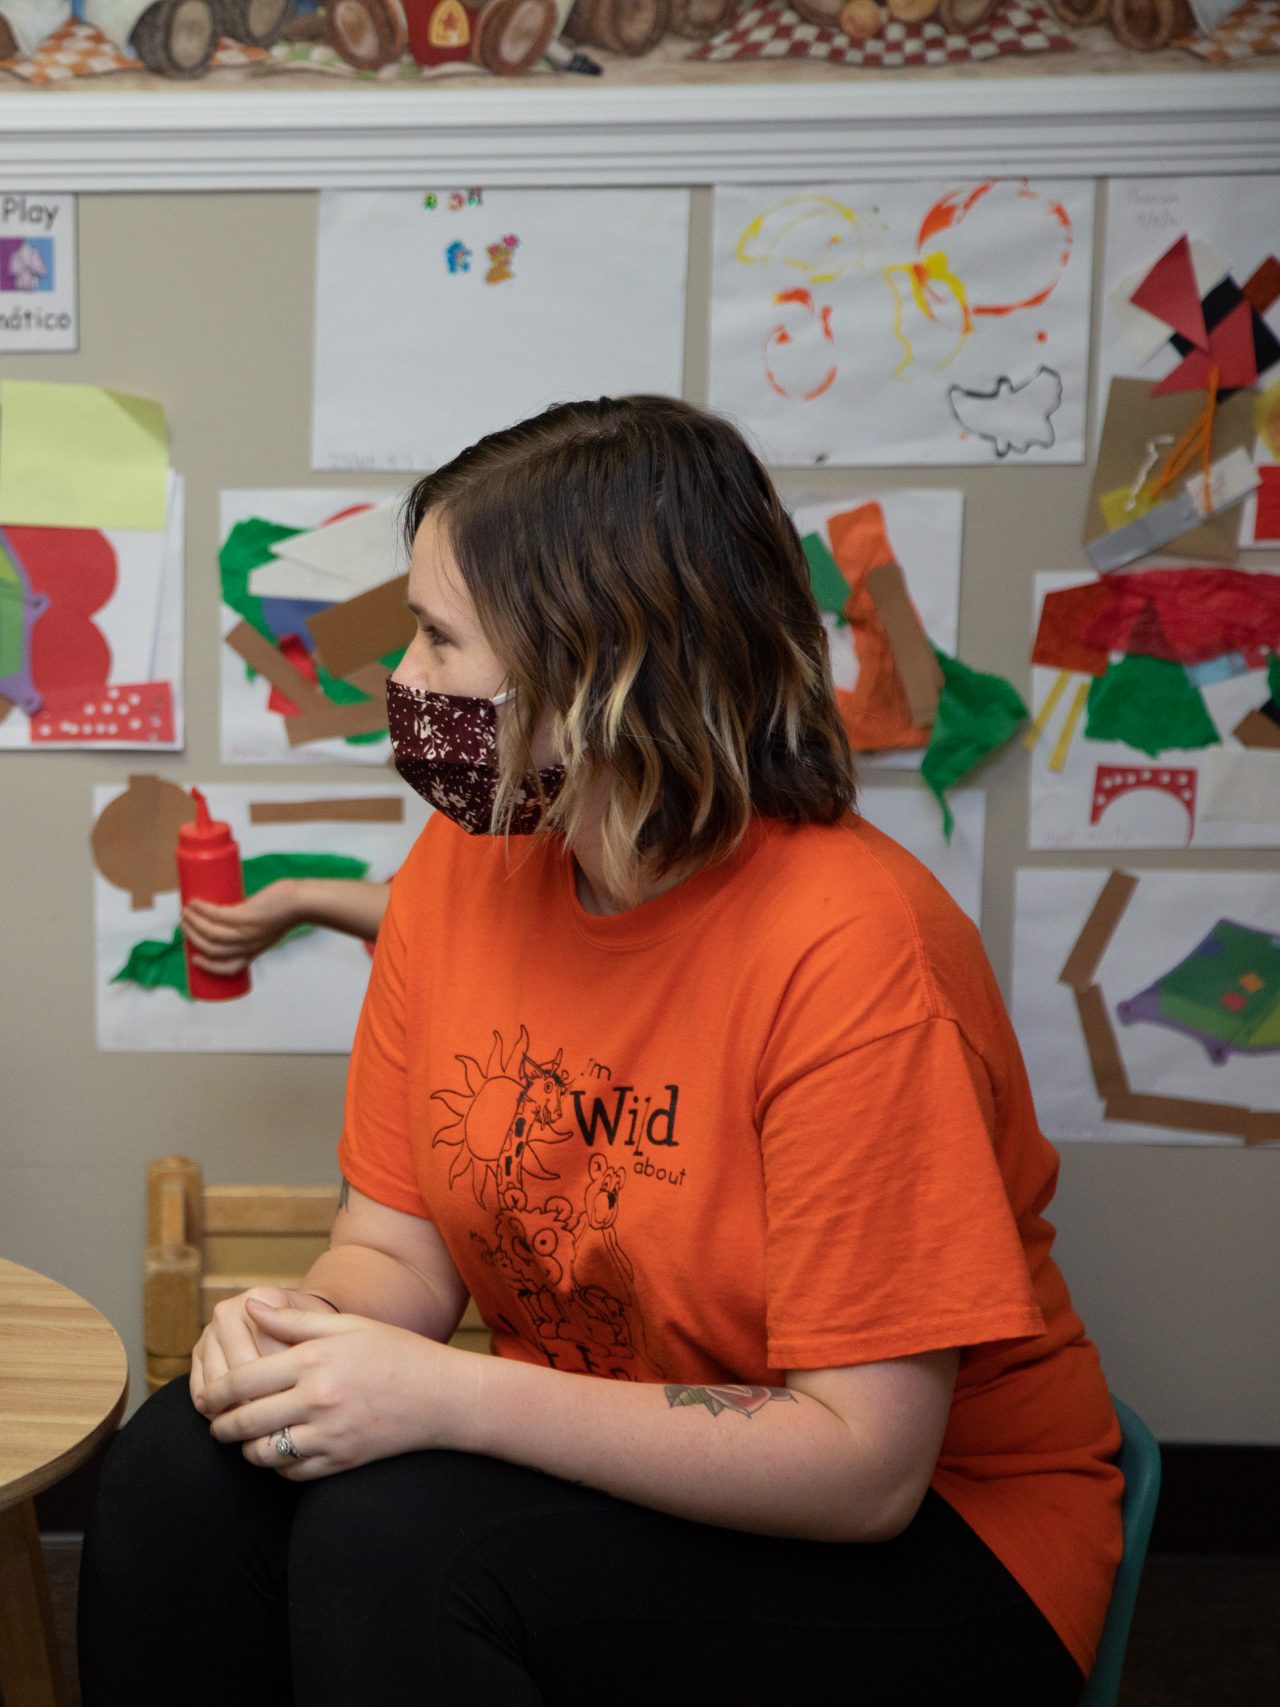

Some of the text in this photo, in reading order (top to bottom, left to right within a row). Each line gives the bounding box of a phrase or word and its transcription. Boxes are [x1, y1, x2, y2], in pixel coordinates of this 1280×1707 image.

[1, 197, 60, 230] Play
[570, 1085, 680, 1156] Wild
[634, 1158, 686, 1186] about
